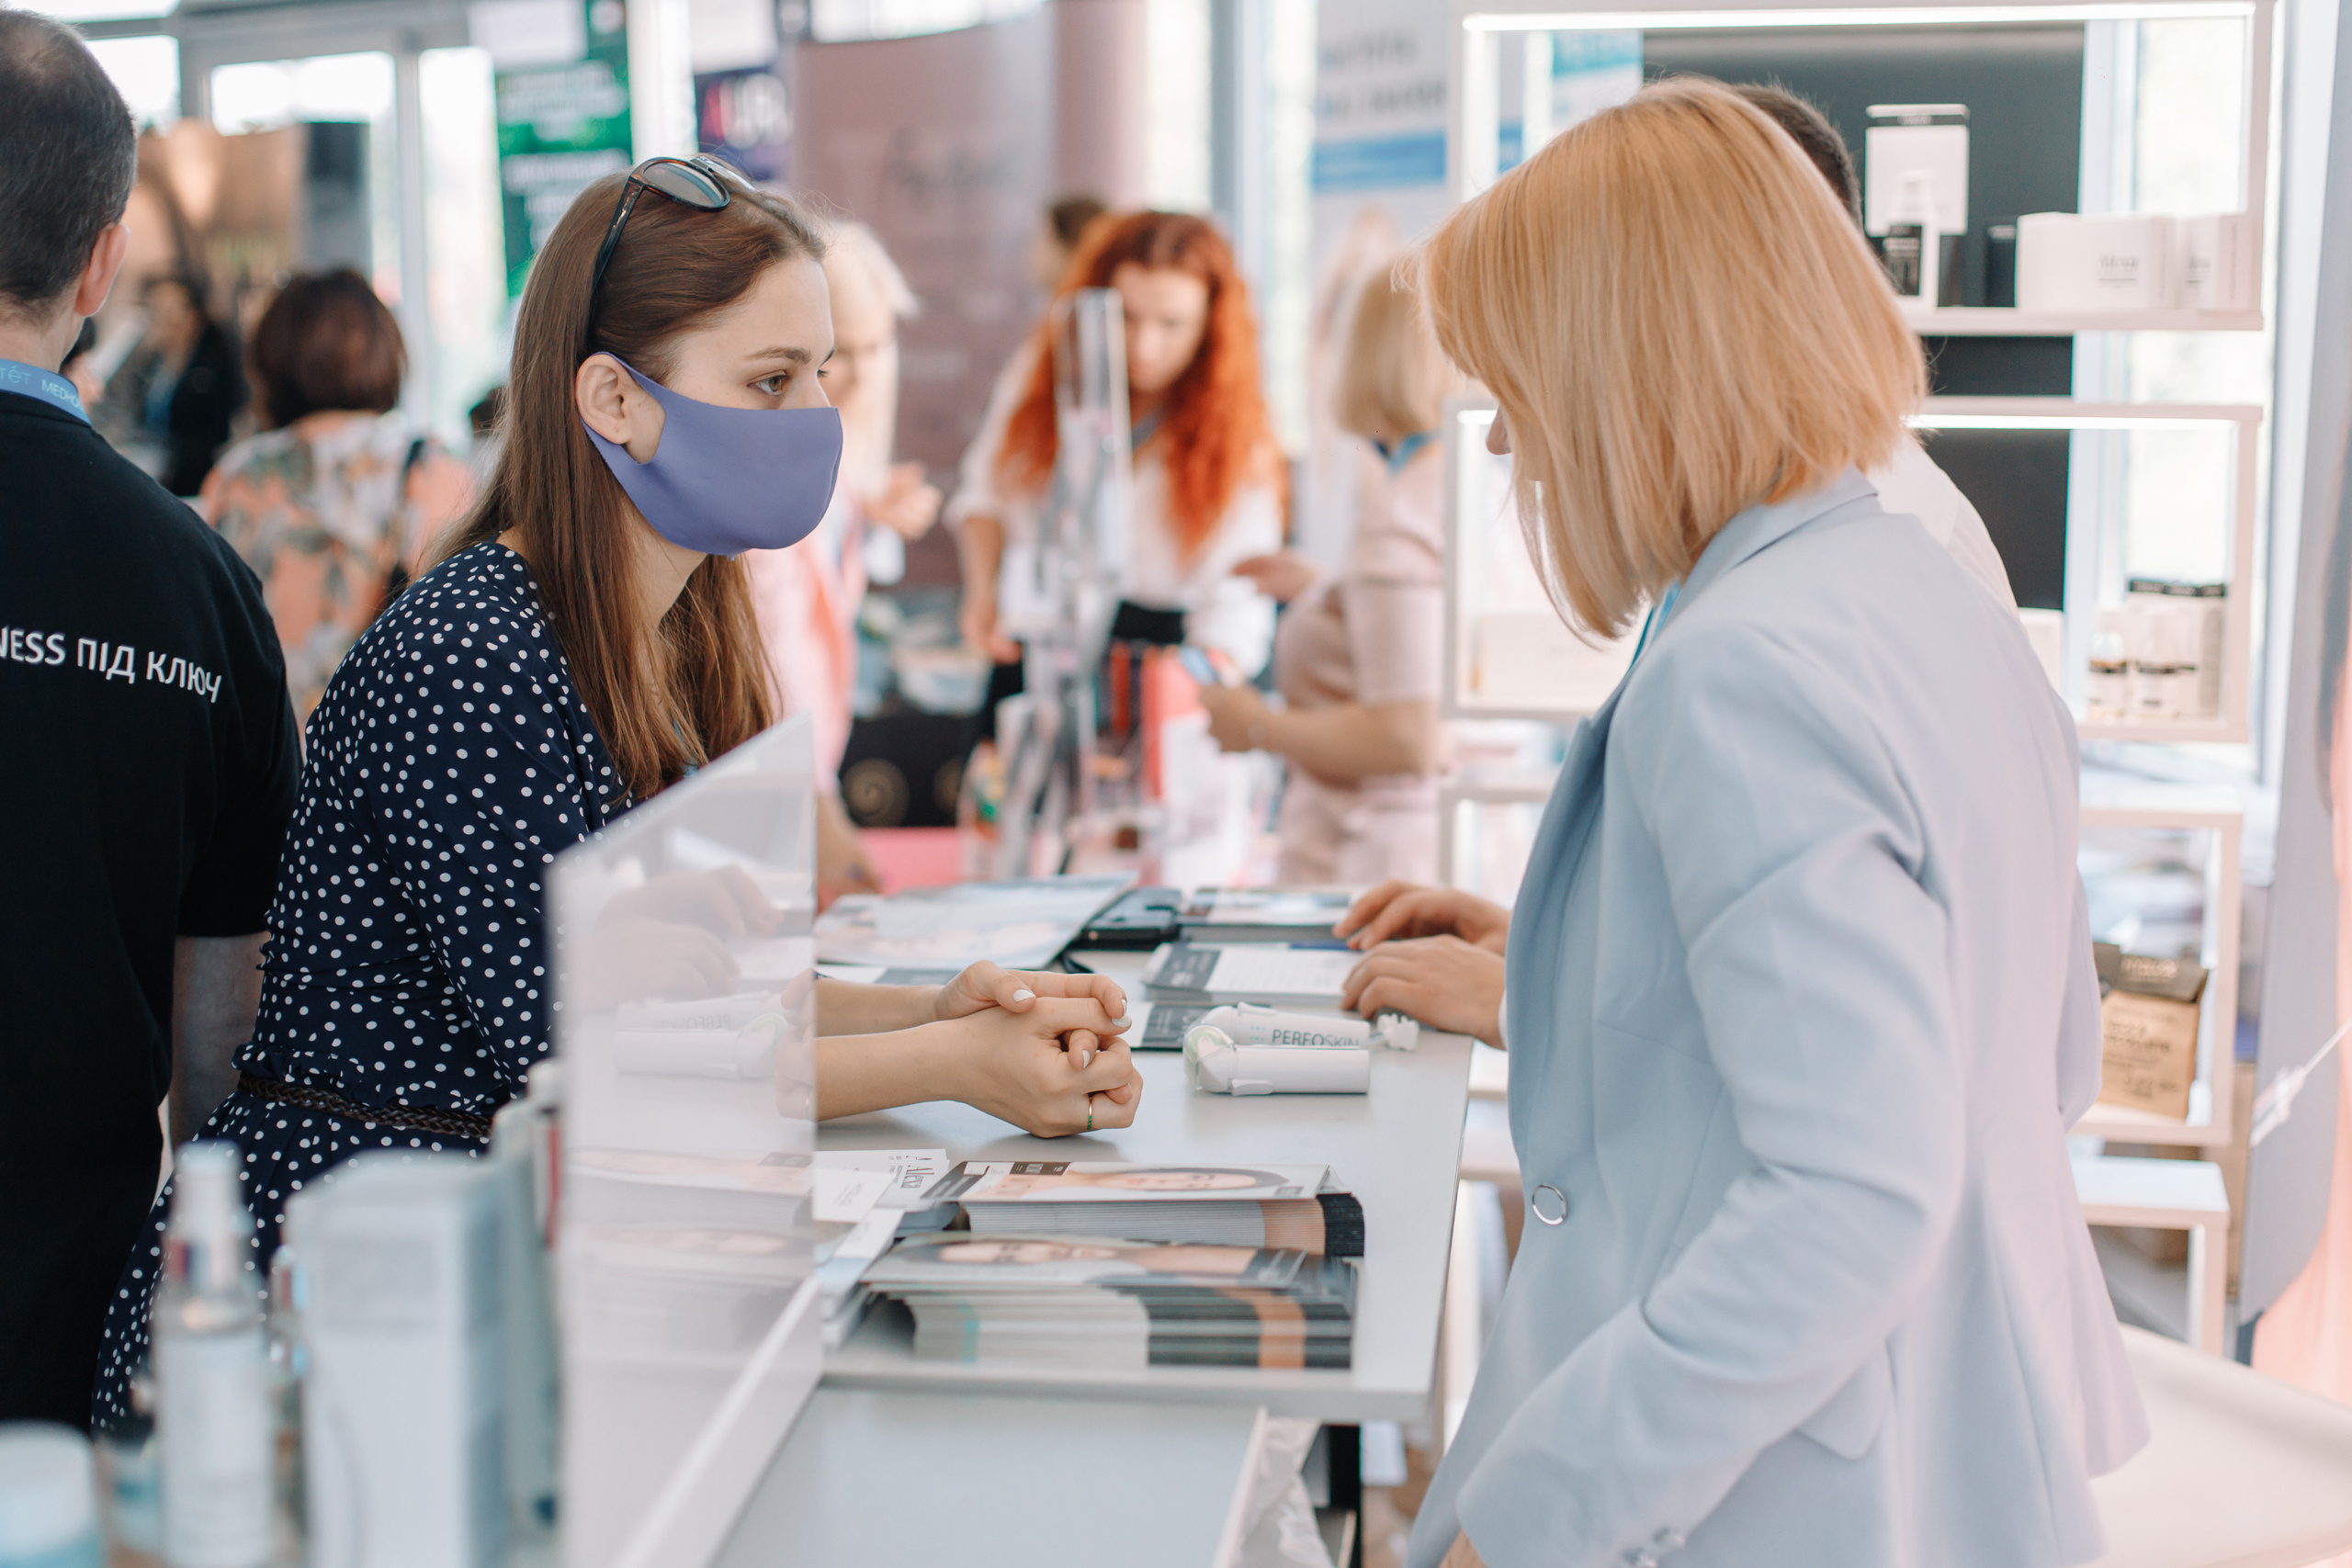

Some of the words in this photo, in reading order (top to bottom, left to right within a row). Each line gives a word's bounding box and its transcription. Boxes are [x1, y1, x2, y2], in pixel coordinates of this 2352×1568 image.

[77, 637, 136, 685] ПІД
[146, 650, 222, 704] КЛЮЧ
[1272, 1029, 1360, 1047] PERFOSKIN
